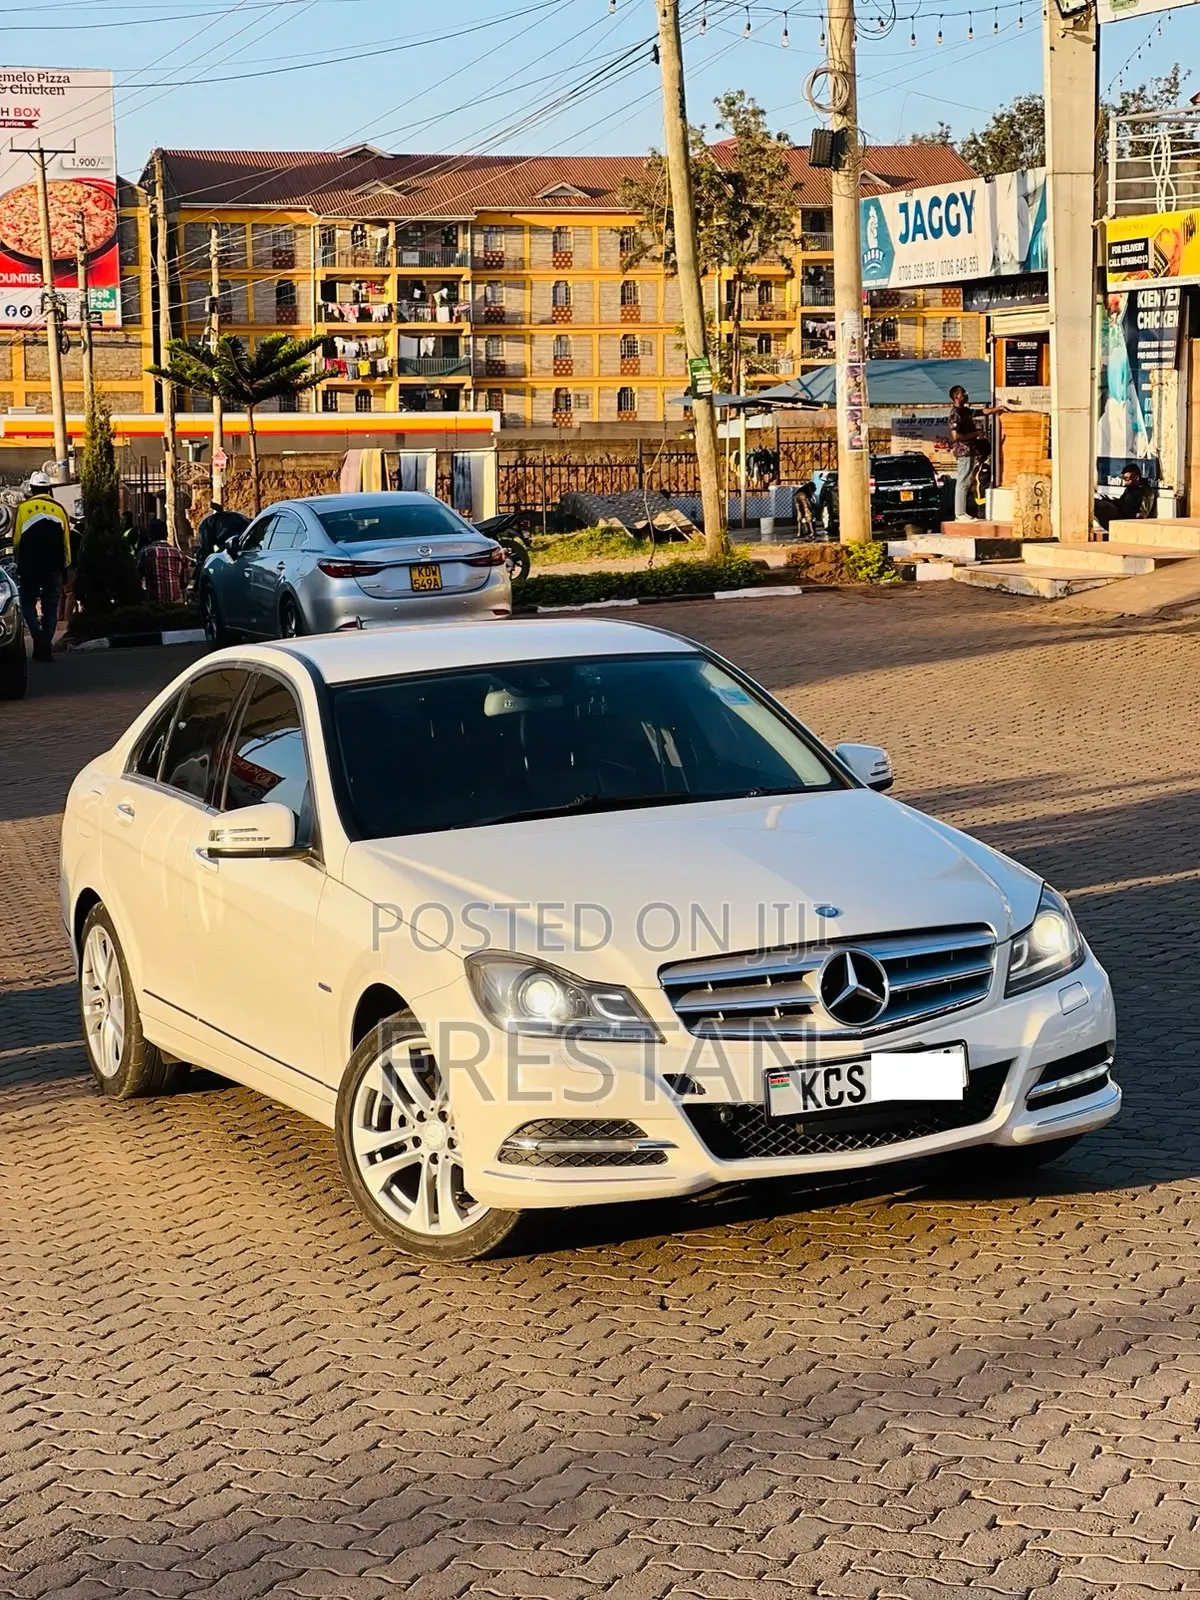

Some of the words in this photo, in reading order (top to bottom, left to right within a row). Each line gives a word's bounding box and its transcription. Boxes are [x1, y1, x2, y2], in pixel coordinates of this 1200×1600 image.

[37, 72, 71, 84] Pizza
[9, 83, 65, 96] Chicken
[13, 107, 41, 117] BOX
[71, 157, 105, 168] 1,900/-
[898, 190, 976, 245] JAGGY
[1111, 245, 1122, 255] FOR
[1122, 242, 1145, 254] DELIVERY
[1108, 258, 1120, 268] CALL
[90, 288, 110, 299] Bolt
[90, 300, 115, 309] Food
[1136, 310, 1180, 330] CHICKEN
[417, 566, 437, 577] KDW
[413, 577, 440, 590] 549A
[801, 1064, 866, 1111] KCS
